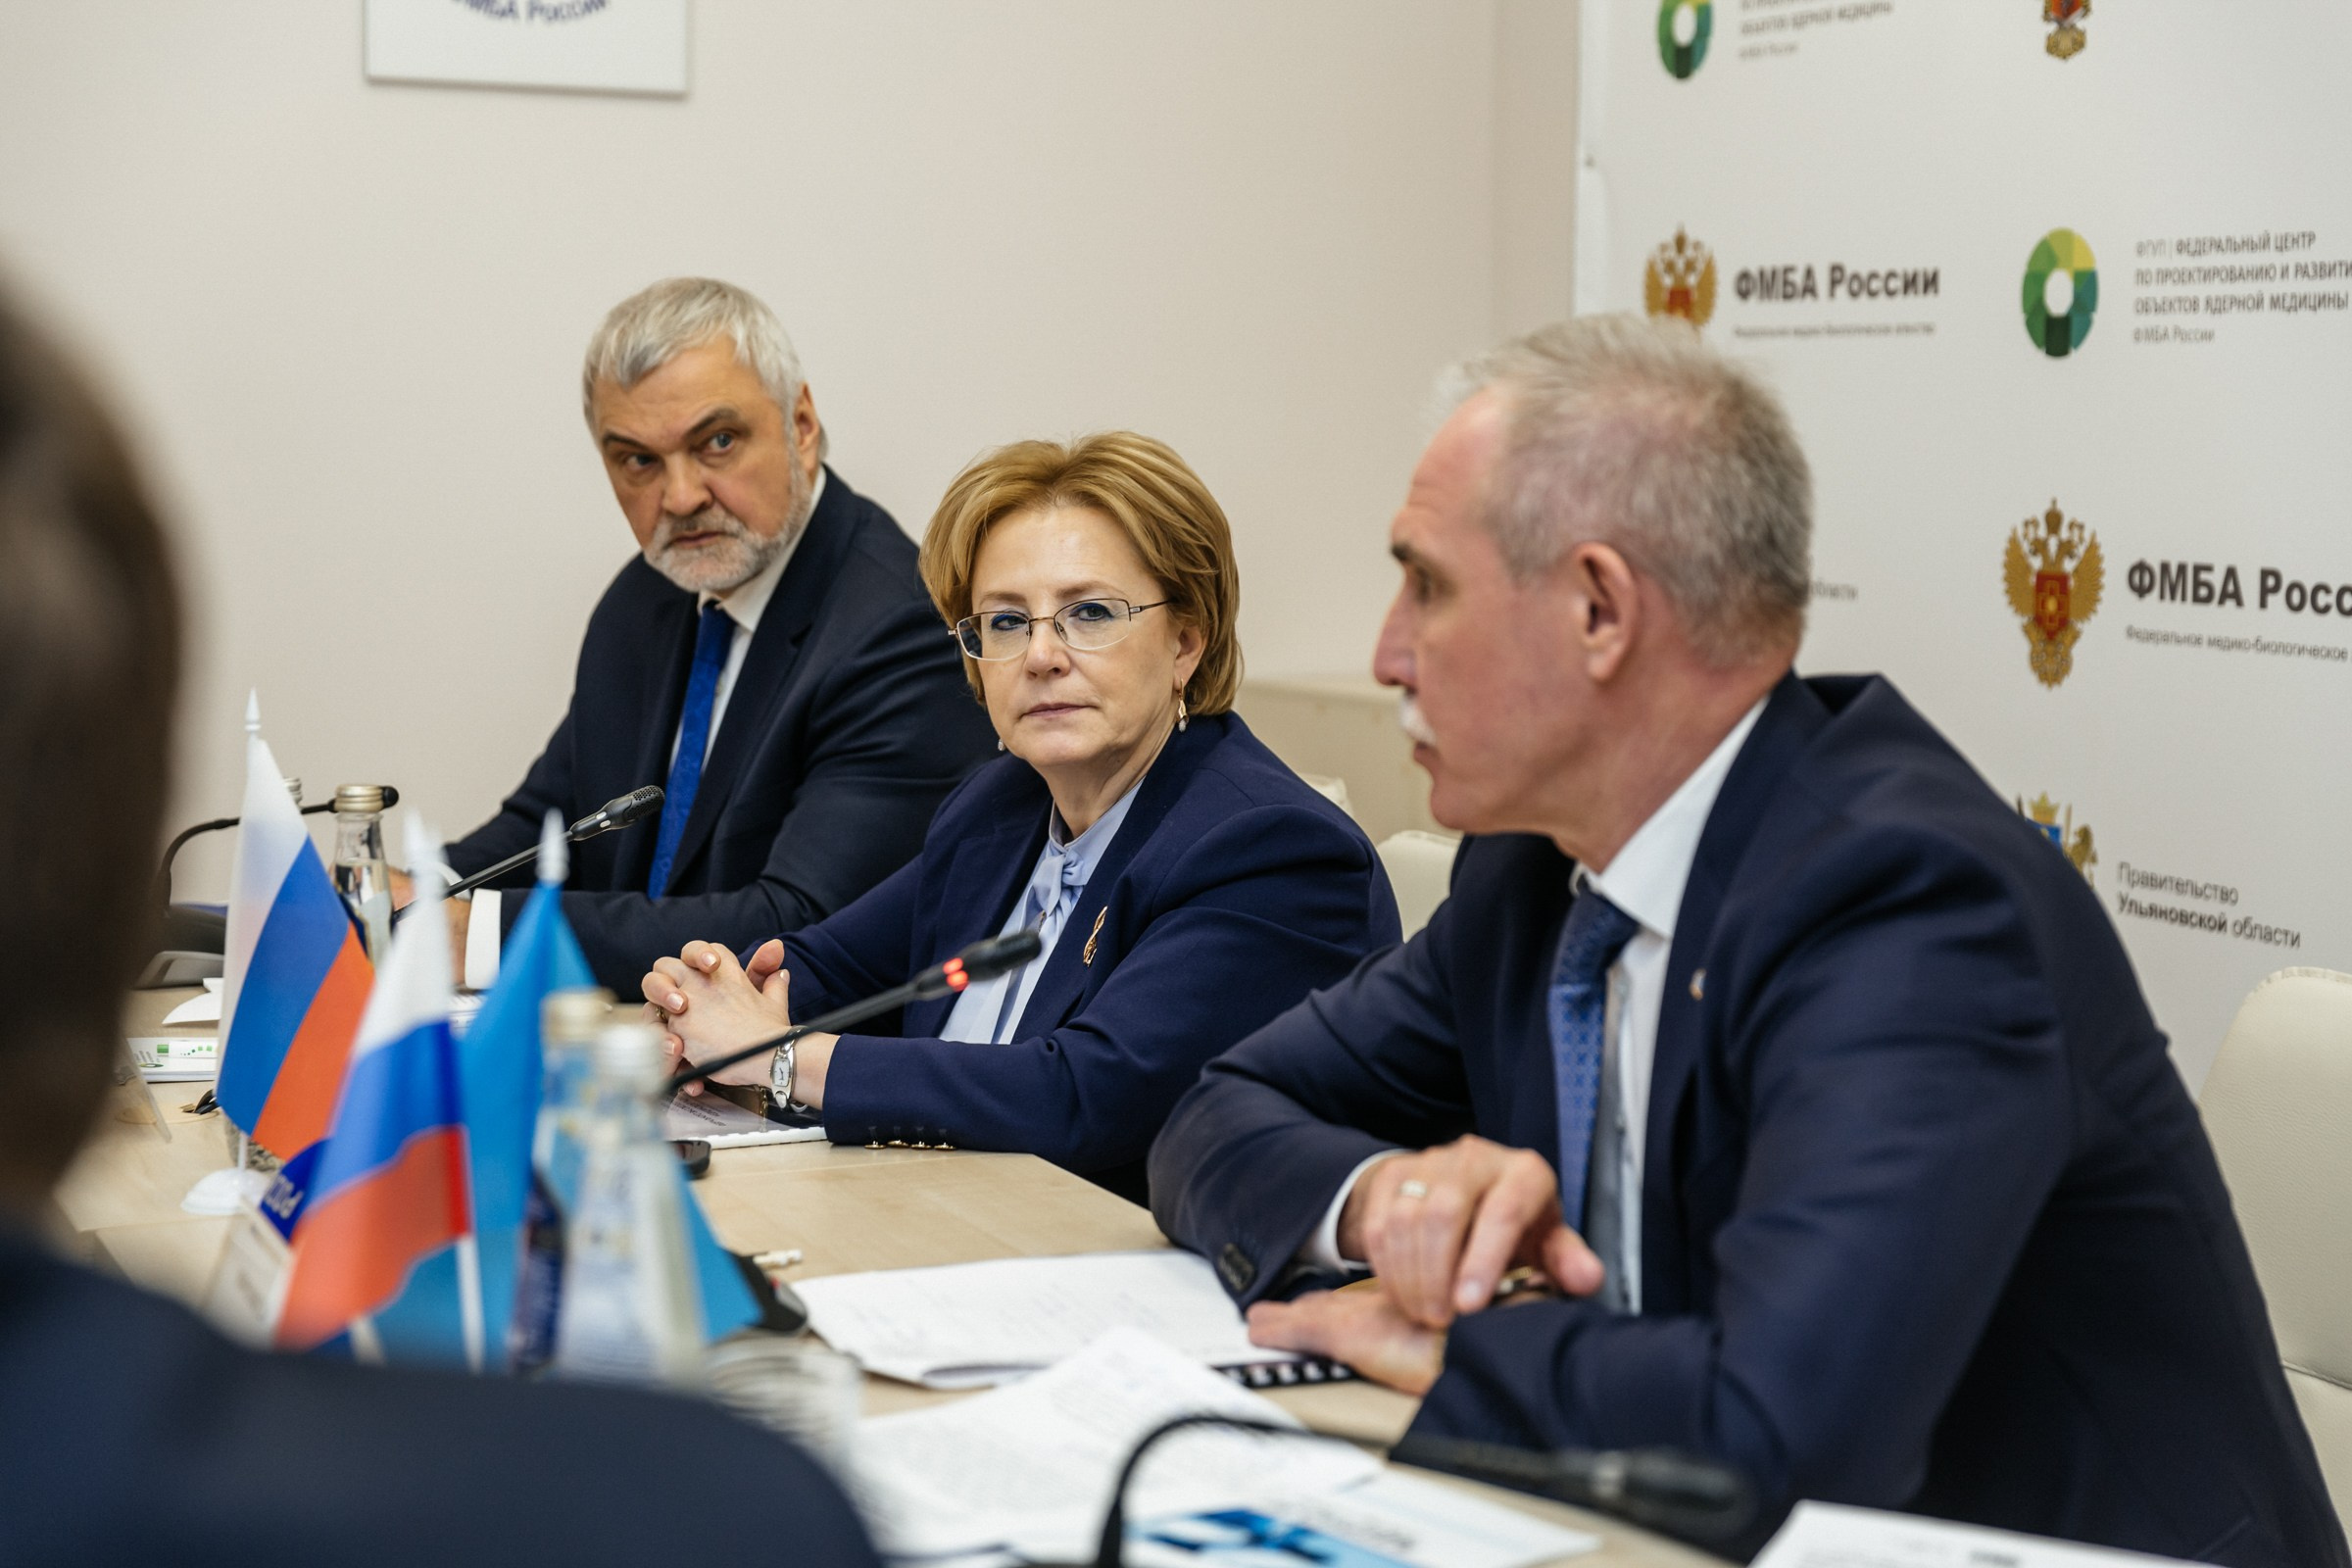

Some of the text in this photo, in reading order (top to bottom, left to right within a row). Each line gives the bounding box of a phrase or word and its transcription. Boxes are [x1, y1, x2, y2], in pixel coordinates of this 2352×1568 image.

[452, 0, 518, 20] МБА
[2176, 230, 2271, 258] ФЕДЕРАЛЬНЫЙ
[2275, 230, 2317, 254] ЦЕНТР
[1735, 262, 1940, 303] ФМБА России
[2134, 268, 2153, 286] ПО
[2155, 262, 2277, 286] ПРОЕКТИРОВАНИЮ
[2280, 264, 2290, 282] И
[2134, 290, 2349, 316] ОБЪЕКТОВ ЯДЕРНОЙ МЕДИЦИНЫ
[2132, 324, 2215, 344] ФМБА России
[2127, 558, 2352, 617] ФМБА Росс
[2126, 624, 2348, 662] Федеральное медико-биологическое
[2118, 860, 2239, 906] Правительство
[2117, 890, 2302, 950] Ульяновской области
